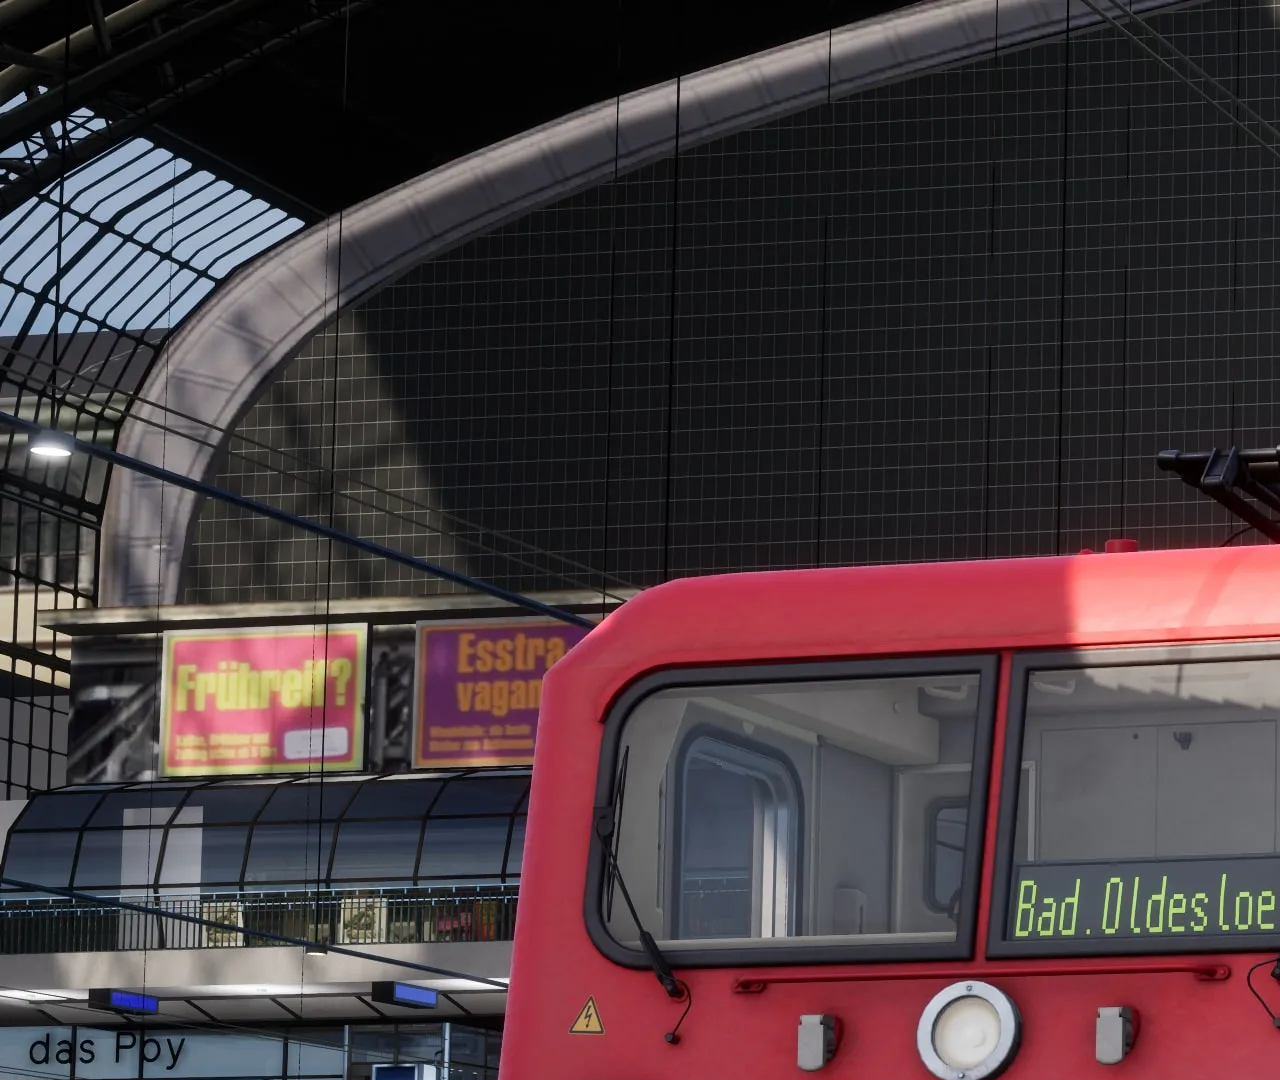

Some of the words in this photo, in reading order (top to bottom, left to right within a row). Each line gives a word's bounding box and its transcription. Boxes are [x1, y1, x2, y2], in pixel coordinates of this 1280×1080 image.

[457, 632, 567, 674] Esstra
[174, 657, 353, 713] Frühreif?
[456, 679, 544, 718] vagan
[29, 1033, 95, 1065] das
